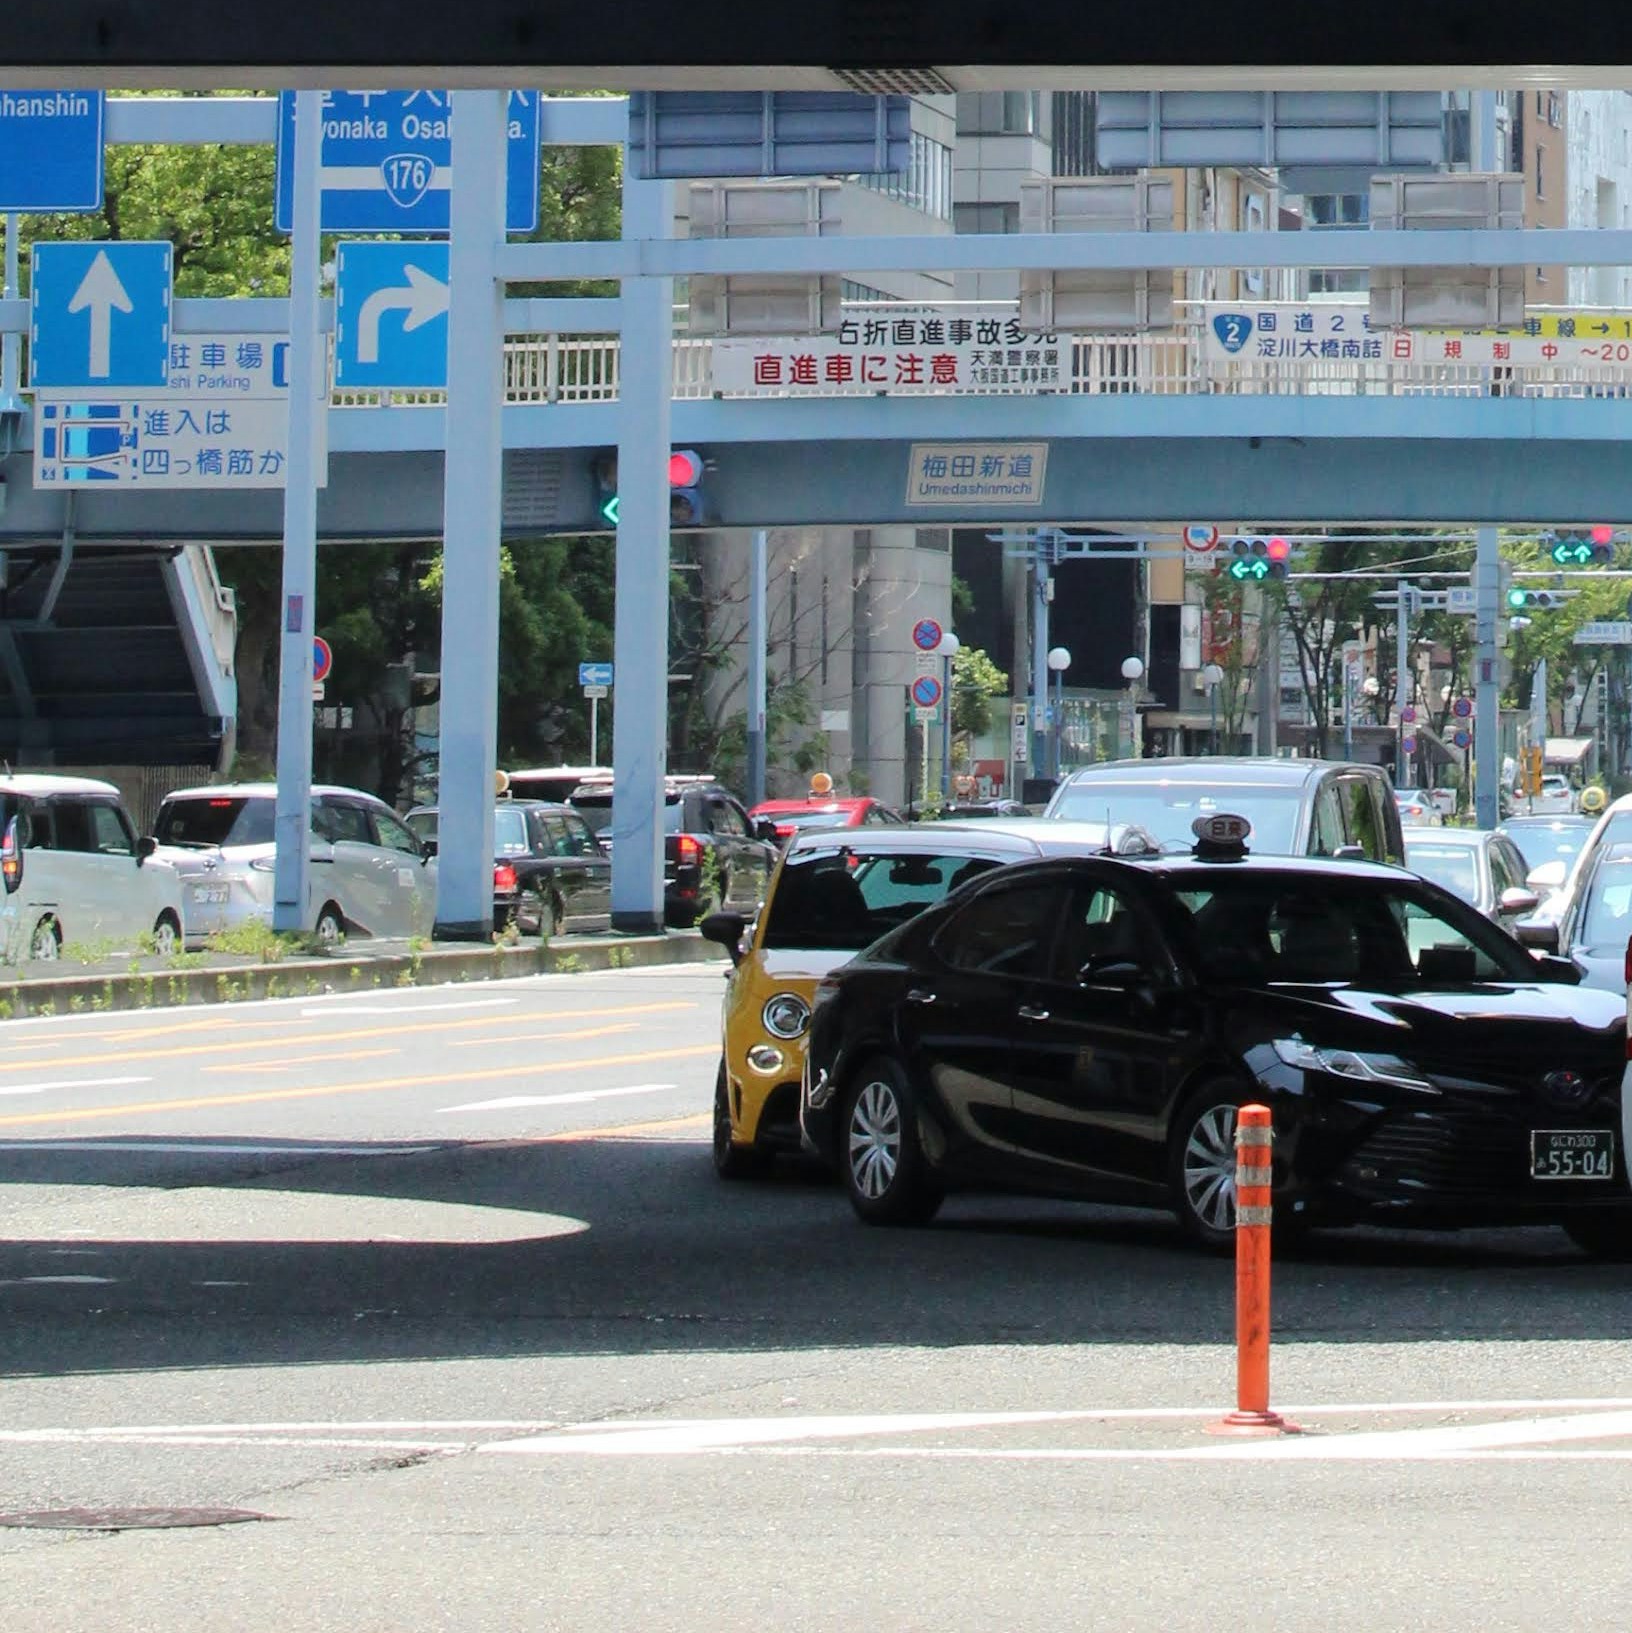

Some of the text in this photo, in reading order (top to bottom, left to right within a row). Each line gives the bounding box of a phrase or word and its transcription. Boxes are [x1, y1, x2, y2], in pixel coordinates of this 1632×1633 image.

[0, 93, 88, 117] hanshin
[402, 115, 452, 139] Osa
[389, 160, 426, 190] 176
[1226, 322, 1240, 342] 2
[1257, 338, 1382, 358] 淀川大橋南詰
[754, 354, 958, 385] 直進車に注意
[198, 374, 250, 392] Parking
[144, 409, 231, 436] 進入は
[922, 454, 1033, 478] 梅田新道
[919, 482, 1032, 495] Umedashinmichi
[1549, 1150, 1608, 1175] 55-04
